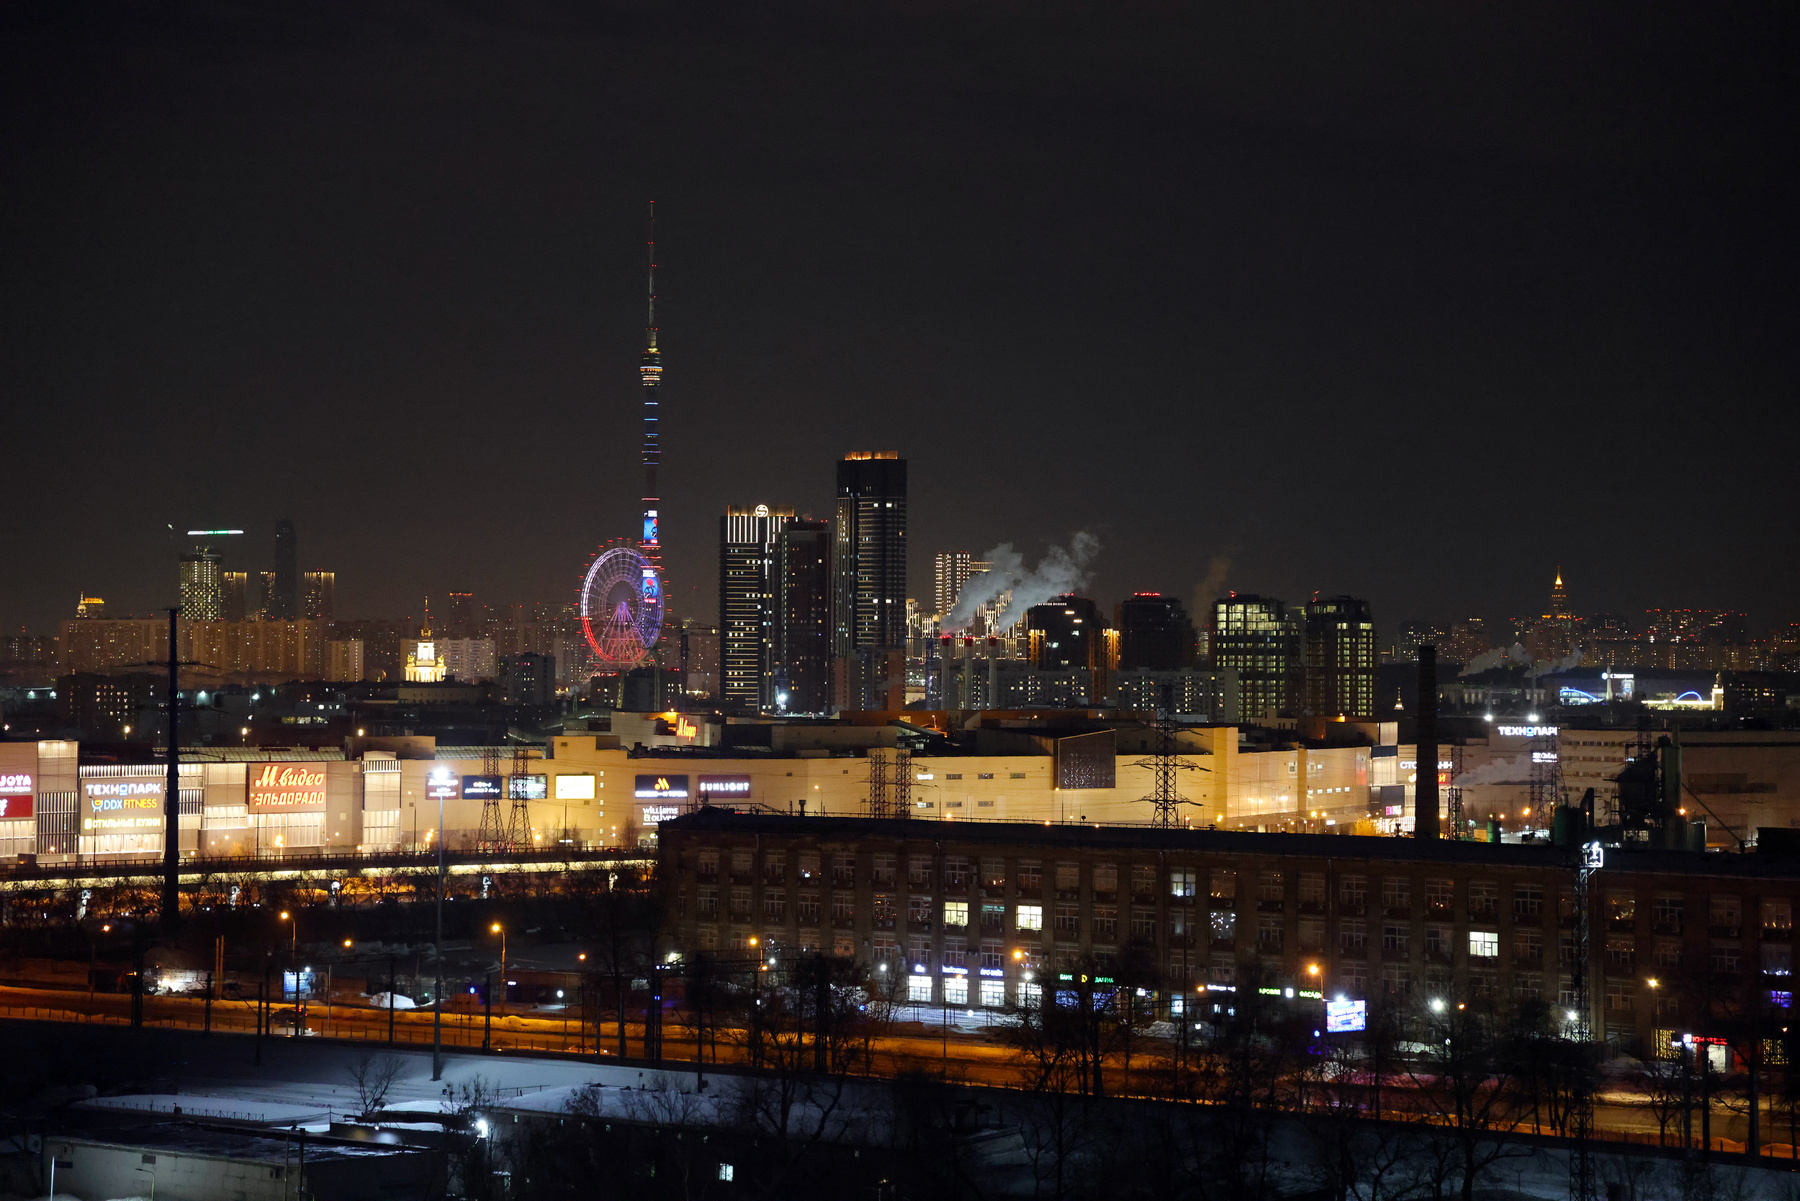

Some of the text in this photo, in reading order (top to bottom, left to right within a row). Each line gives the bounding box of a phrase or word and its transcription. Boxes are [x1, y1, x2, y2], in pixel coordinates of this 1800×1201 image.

[254, 765, 325, 787] М.видео
[85, 783, 161, 796] ТЕХНОПАРК
[700, 782, 750, 791] SUNLIGHT
[103, 798, 158, 810] DDX FITNESS
[254, 791, 326, 806] ЭЛЬДОРАДО
[92, 818, 161, 828] СТИЛЬНЫЕ КУХНИ
